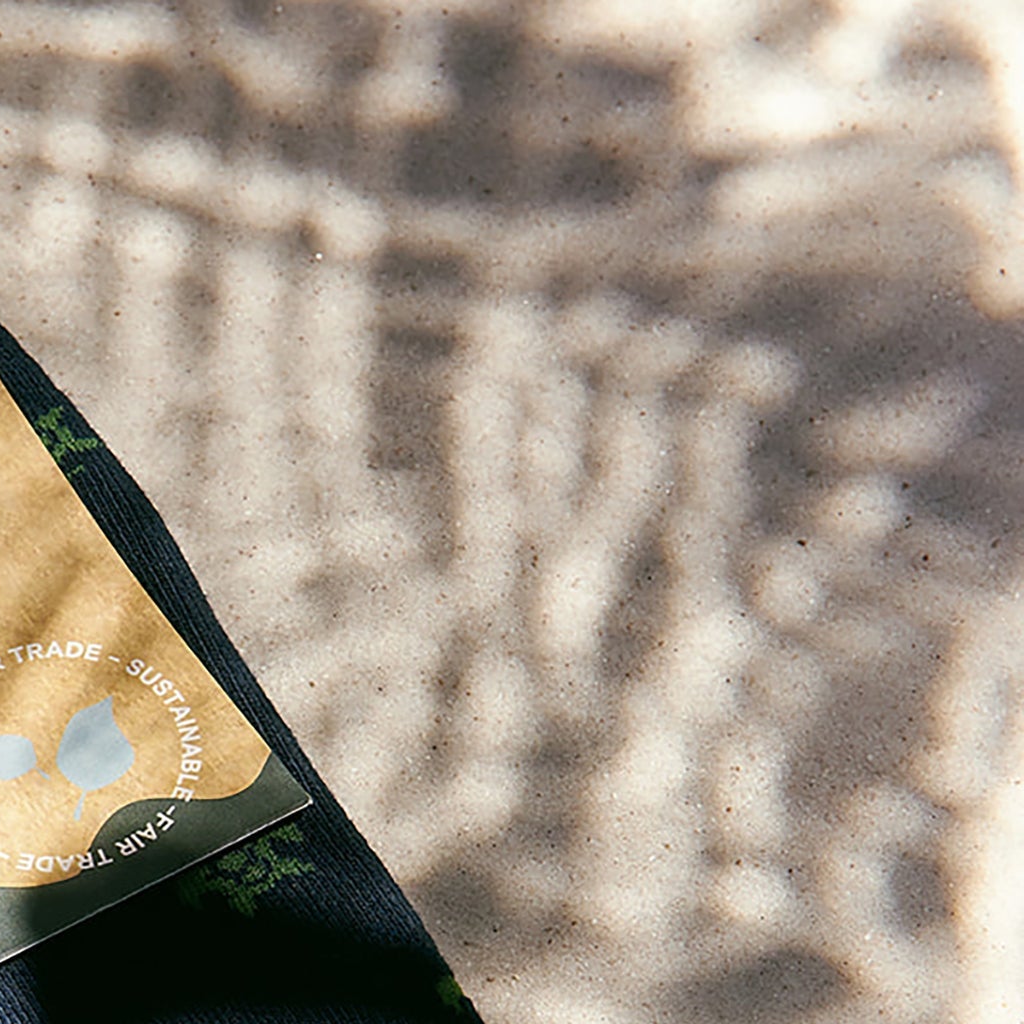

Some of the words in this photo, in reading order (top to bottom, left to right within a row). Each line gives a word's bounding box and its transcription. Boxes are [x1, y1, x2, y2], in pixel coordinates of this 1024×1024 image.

[8, 641, 102, 664] TRADE
[126, 658, 202, 802] SUSTAINABLE
[114, 811, 175, 858] FAIR
[16, 848, 113, 872] TRADE
